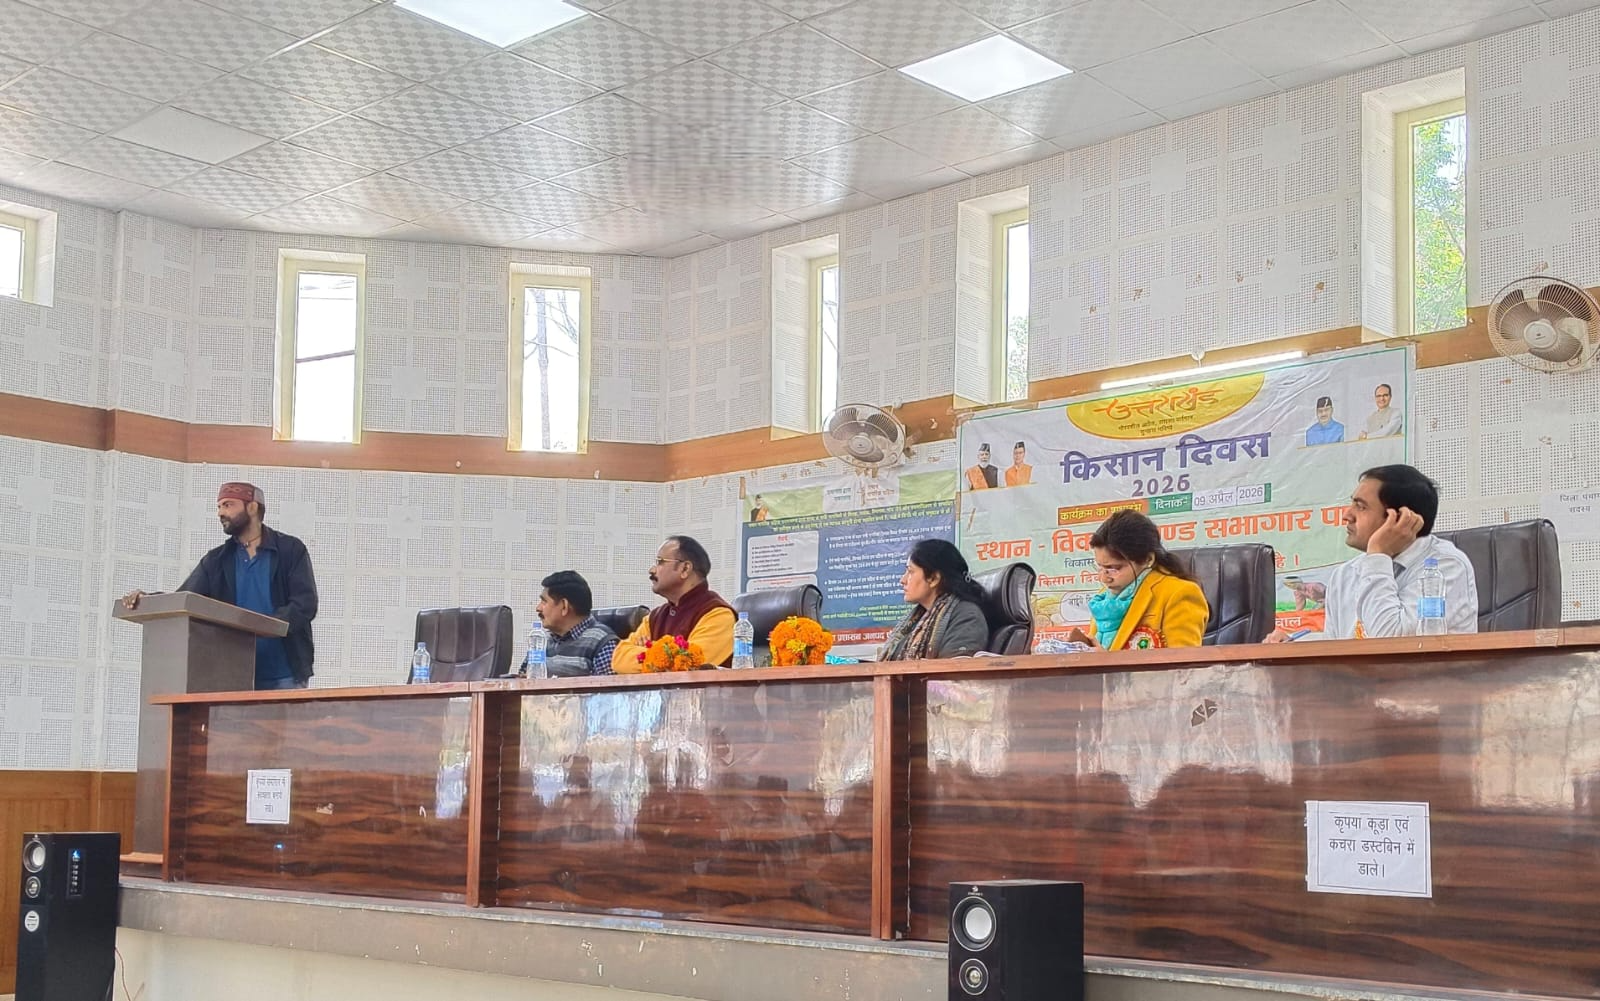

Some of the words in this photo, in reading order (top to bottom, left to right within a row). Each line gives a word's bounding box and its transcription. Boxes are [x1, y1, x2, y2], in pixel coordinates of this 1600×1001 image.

[1060, 447, 1165, 483] किसान
[1176, 432, 1271, 468] दिवस
[1132, 474, 1191, 497] 2026
[1194, 495, 1206, 507] 09
[1239, 486, 1263, 499] 2026
[1060, 507, 1092, 520] कार्यक्रम
[1096, 506, 1107, 516] का
[976, 539, 1032, 561] स्थान
[1204, 509, 1313, 538] सभागार
[1038, 574, 1076, 588] किसान
[1334, 816, 1362, 834] कृपया
[1367, 817, 1390, 835] कूड़ा
[1395, 815, 1410, 834] एवं
[1329, 838, 1356, 852] कचरा
[1406, 838, 1415, 856] में
